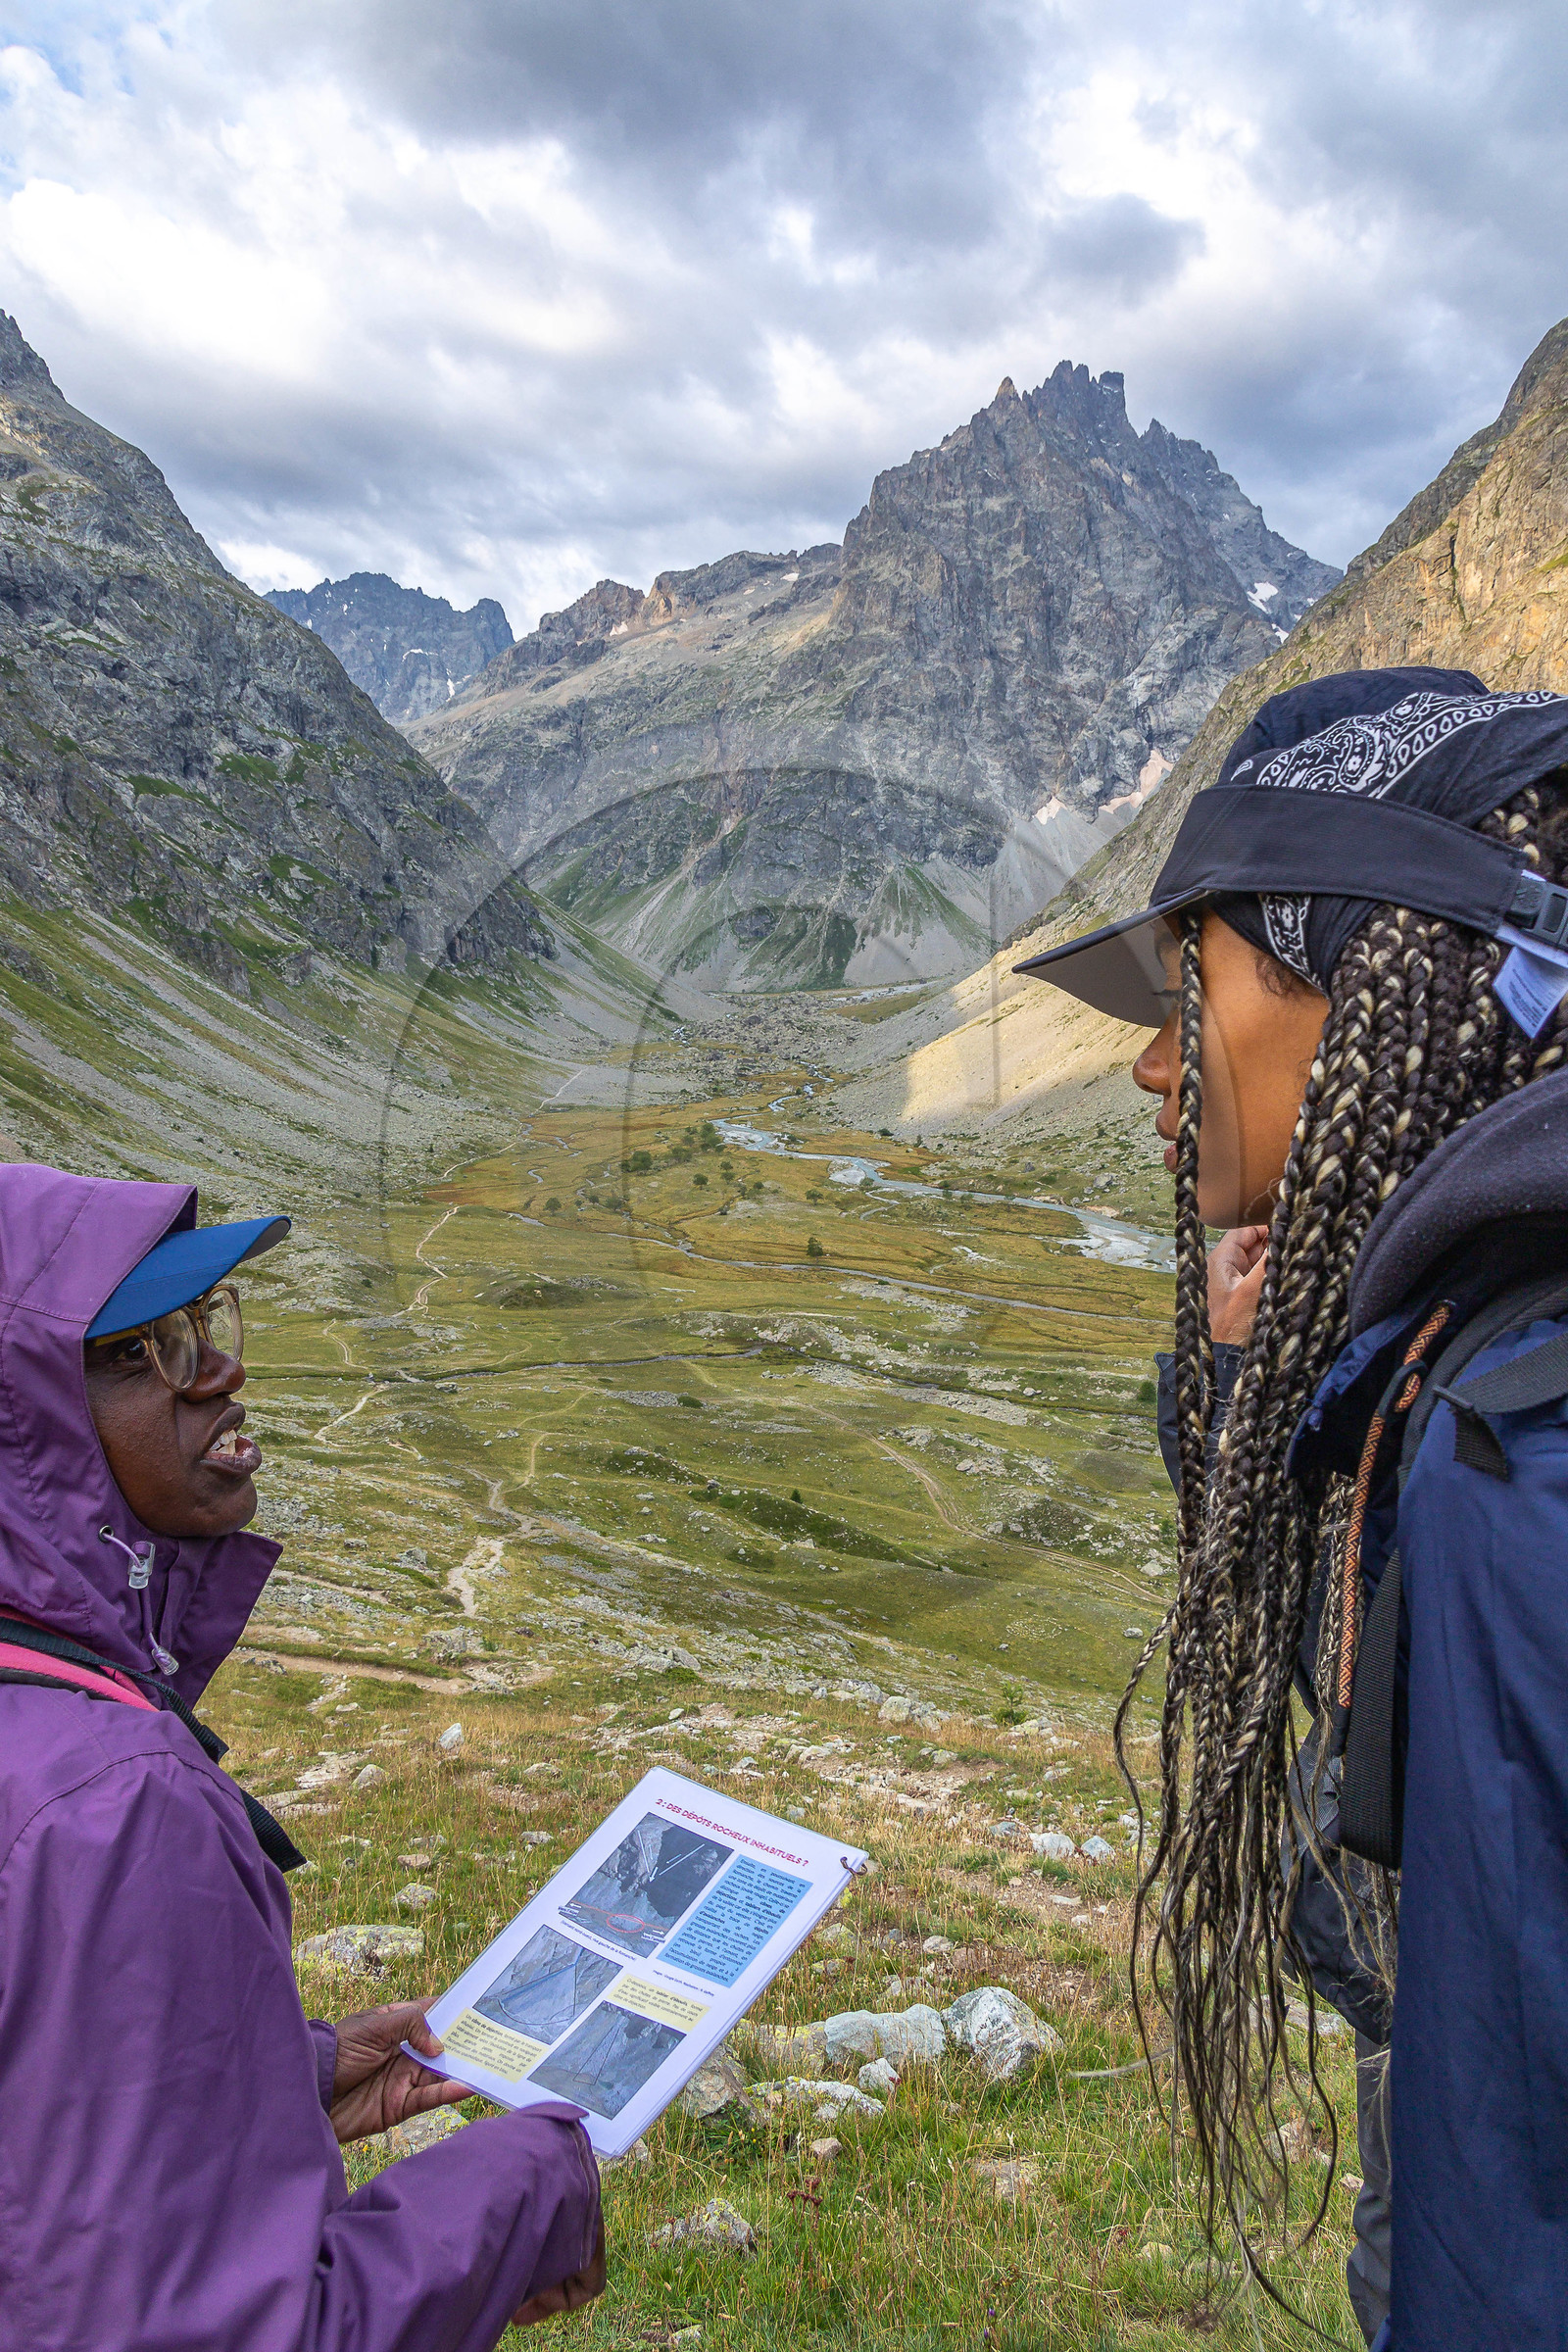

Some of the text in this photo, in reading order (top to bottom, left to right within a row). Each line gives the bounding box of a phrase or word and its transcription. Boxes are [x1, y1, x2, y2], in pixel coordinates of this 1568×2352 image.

[665, 1802, 683, 1813] DES
[680, 1808, 713, 1827] DÉPÔTS
[710, 1823, 752, 1843] ROCHEUX
[749, 1838, 803, 1865] INHABITUELS
